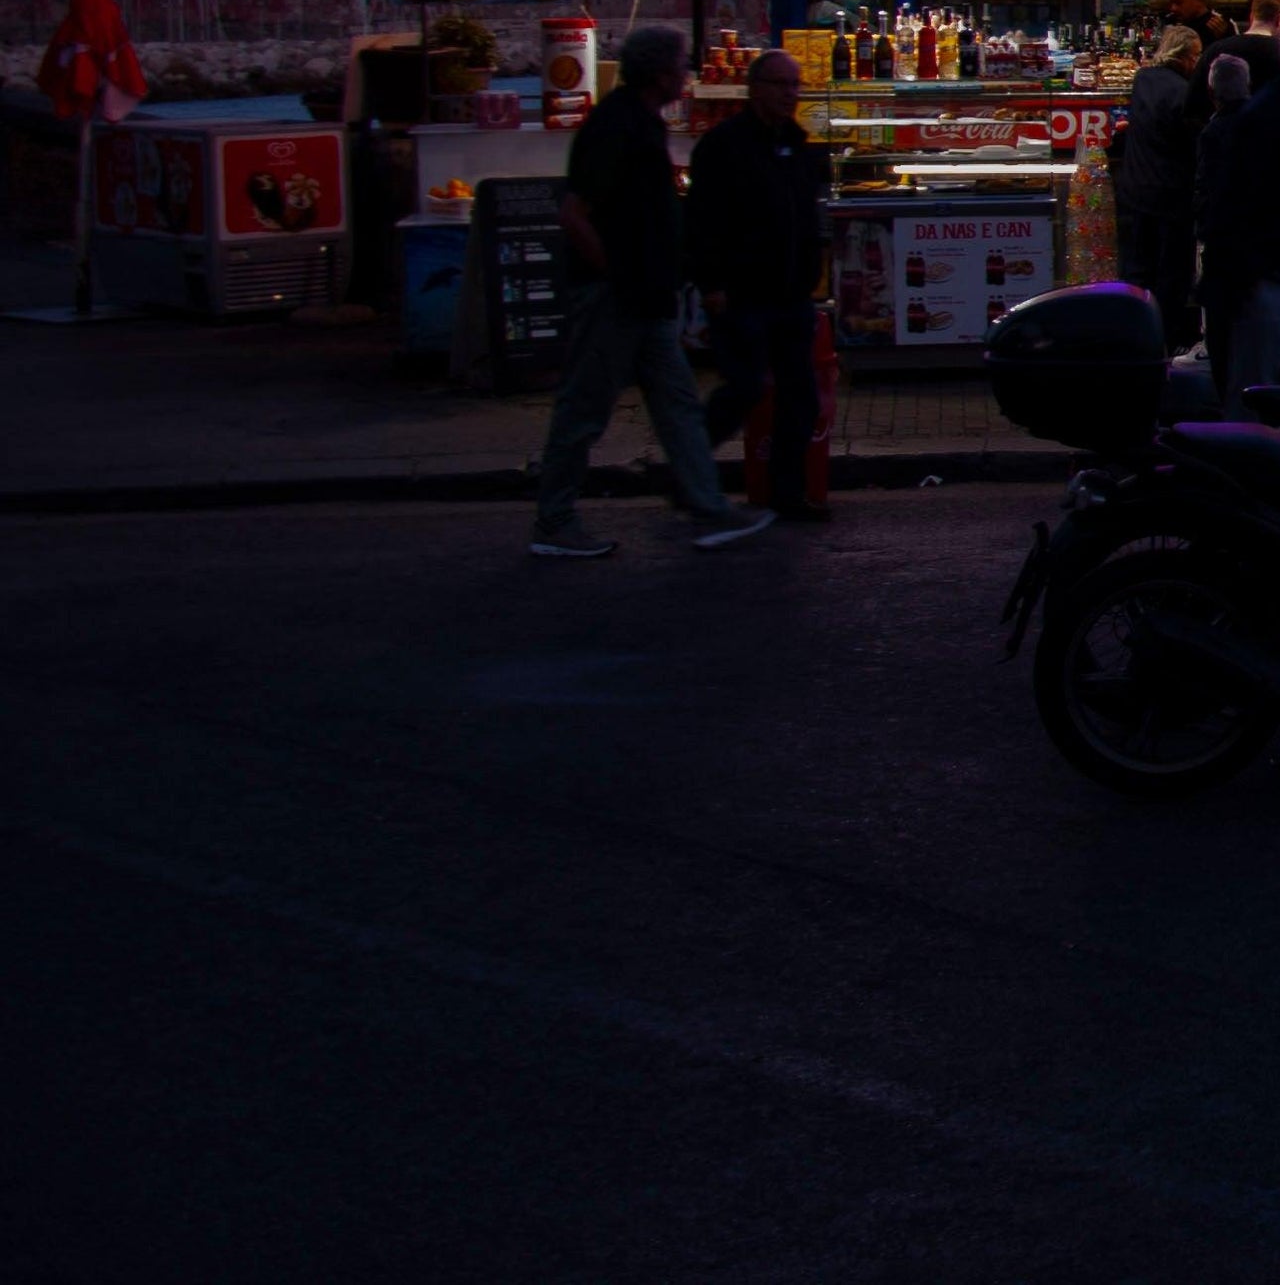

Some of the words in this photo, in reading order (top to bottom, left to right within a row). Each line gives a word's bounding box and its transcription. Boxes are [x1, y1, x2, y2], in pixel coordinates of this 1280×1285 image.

[915, 224, 938, 240] DA
[942, 223, 976, 240] NAS
[982, 222, 993, 238] E
[996, 221, 1032, 238] CAN
